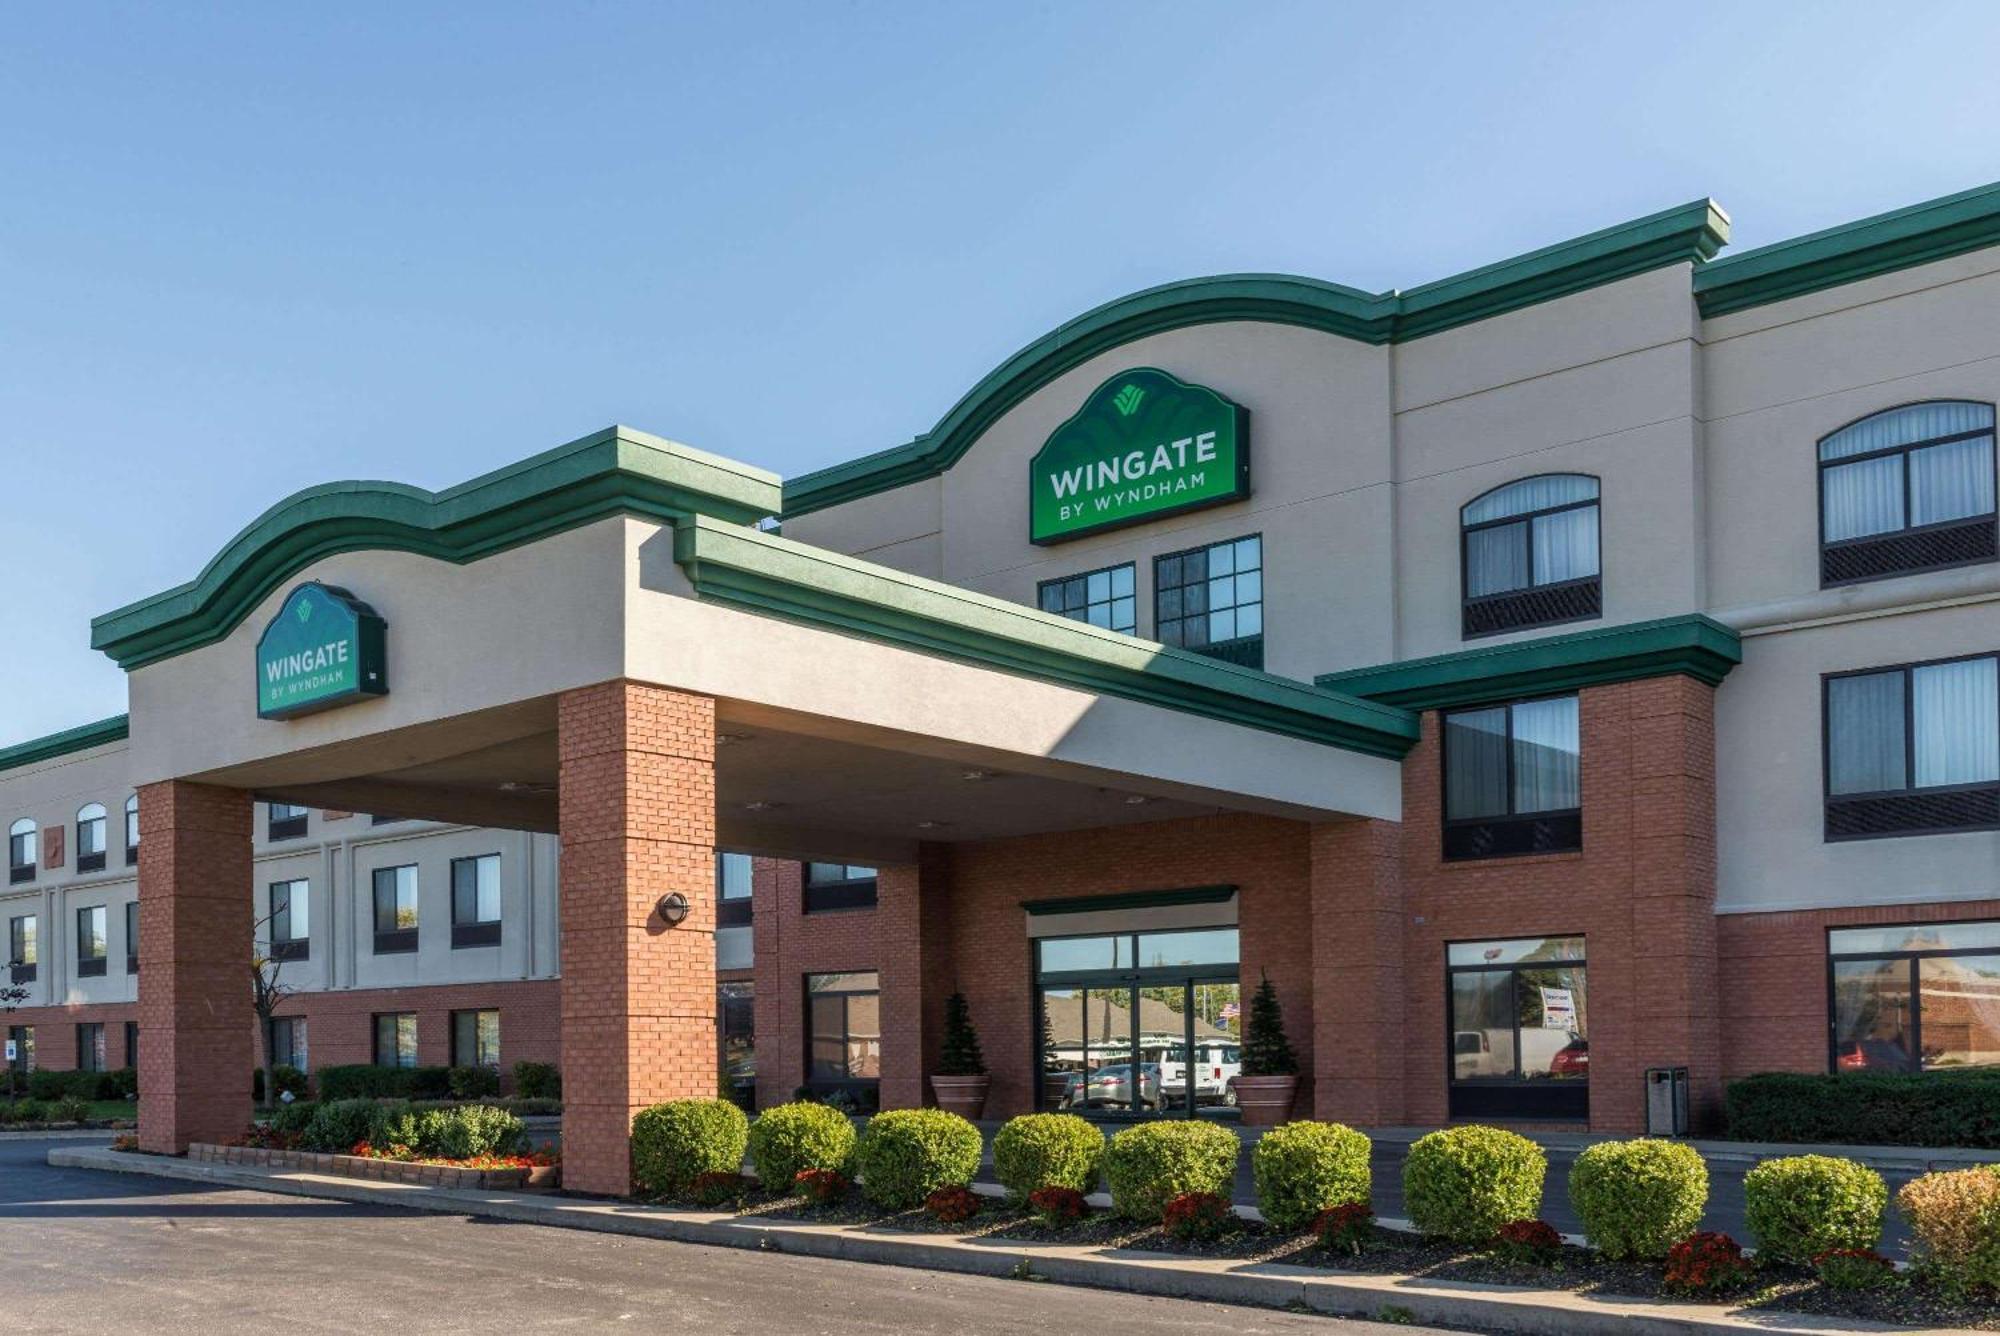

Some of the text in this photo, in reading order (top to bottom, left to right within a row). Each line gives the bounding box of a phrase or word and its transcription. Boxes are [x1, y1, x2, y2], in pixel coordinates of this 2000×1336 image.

[1050, 431, 1216, 499] WINGATE
[1060, 472, 1205, 521] BY WYNDHAM
[266, 640, 348, 682] WINGATE
[271, 670, 343, 699] BY WYNDHAM
